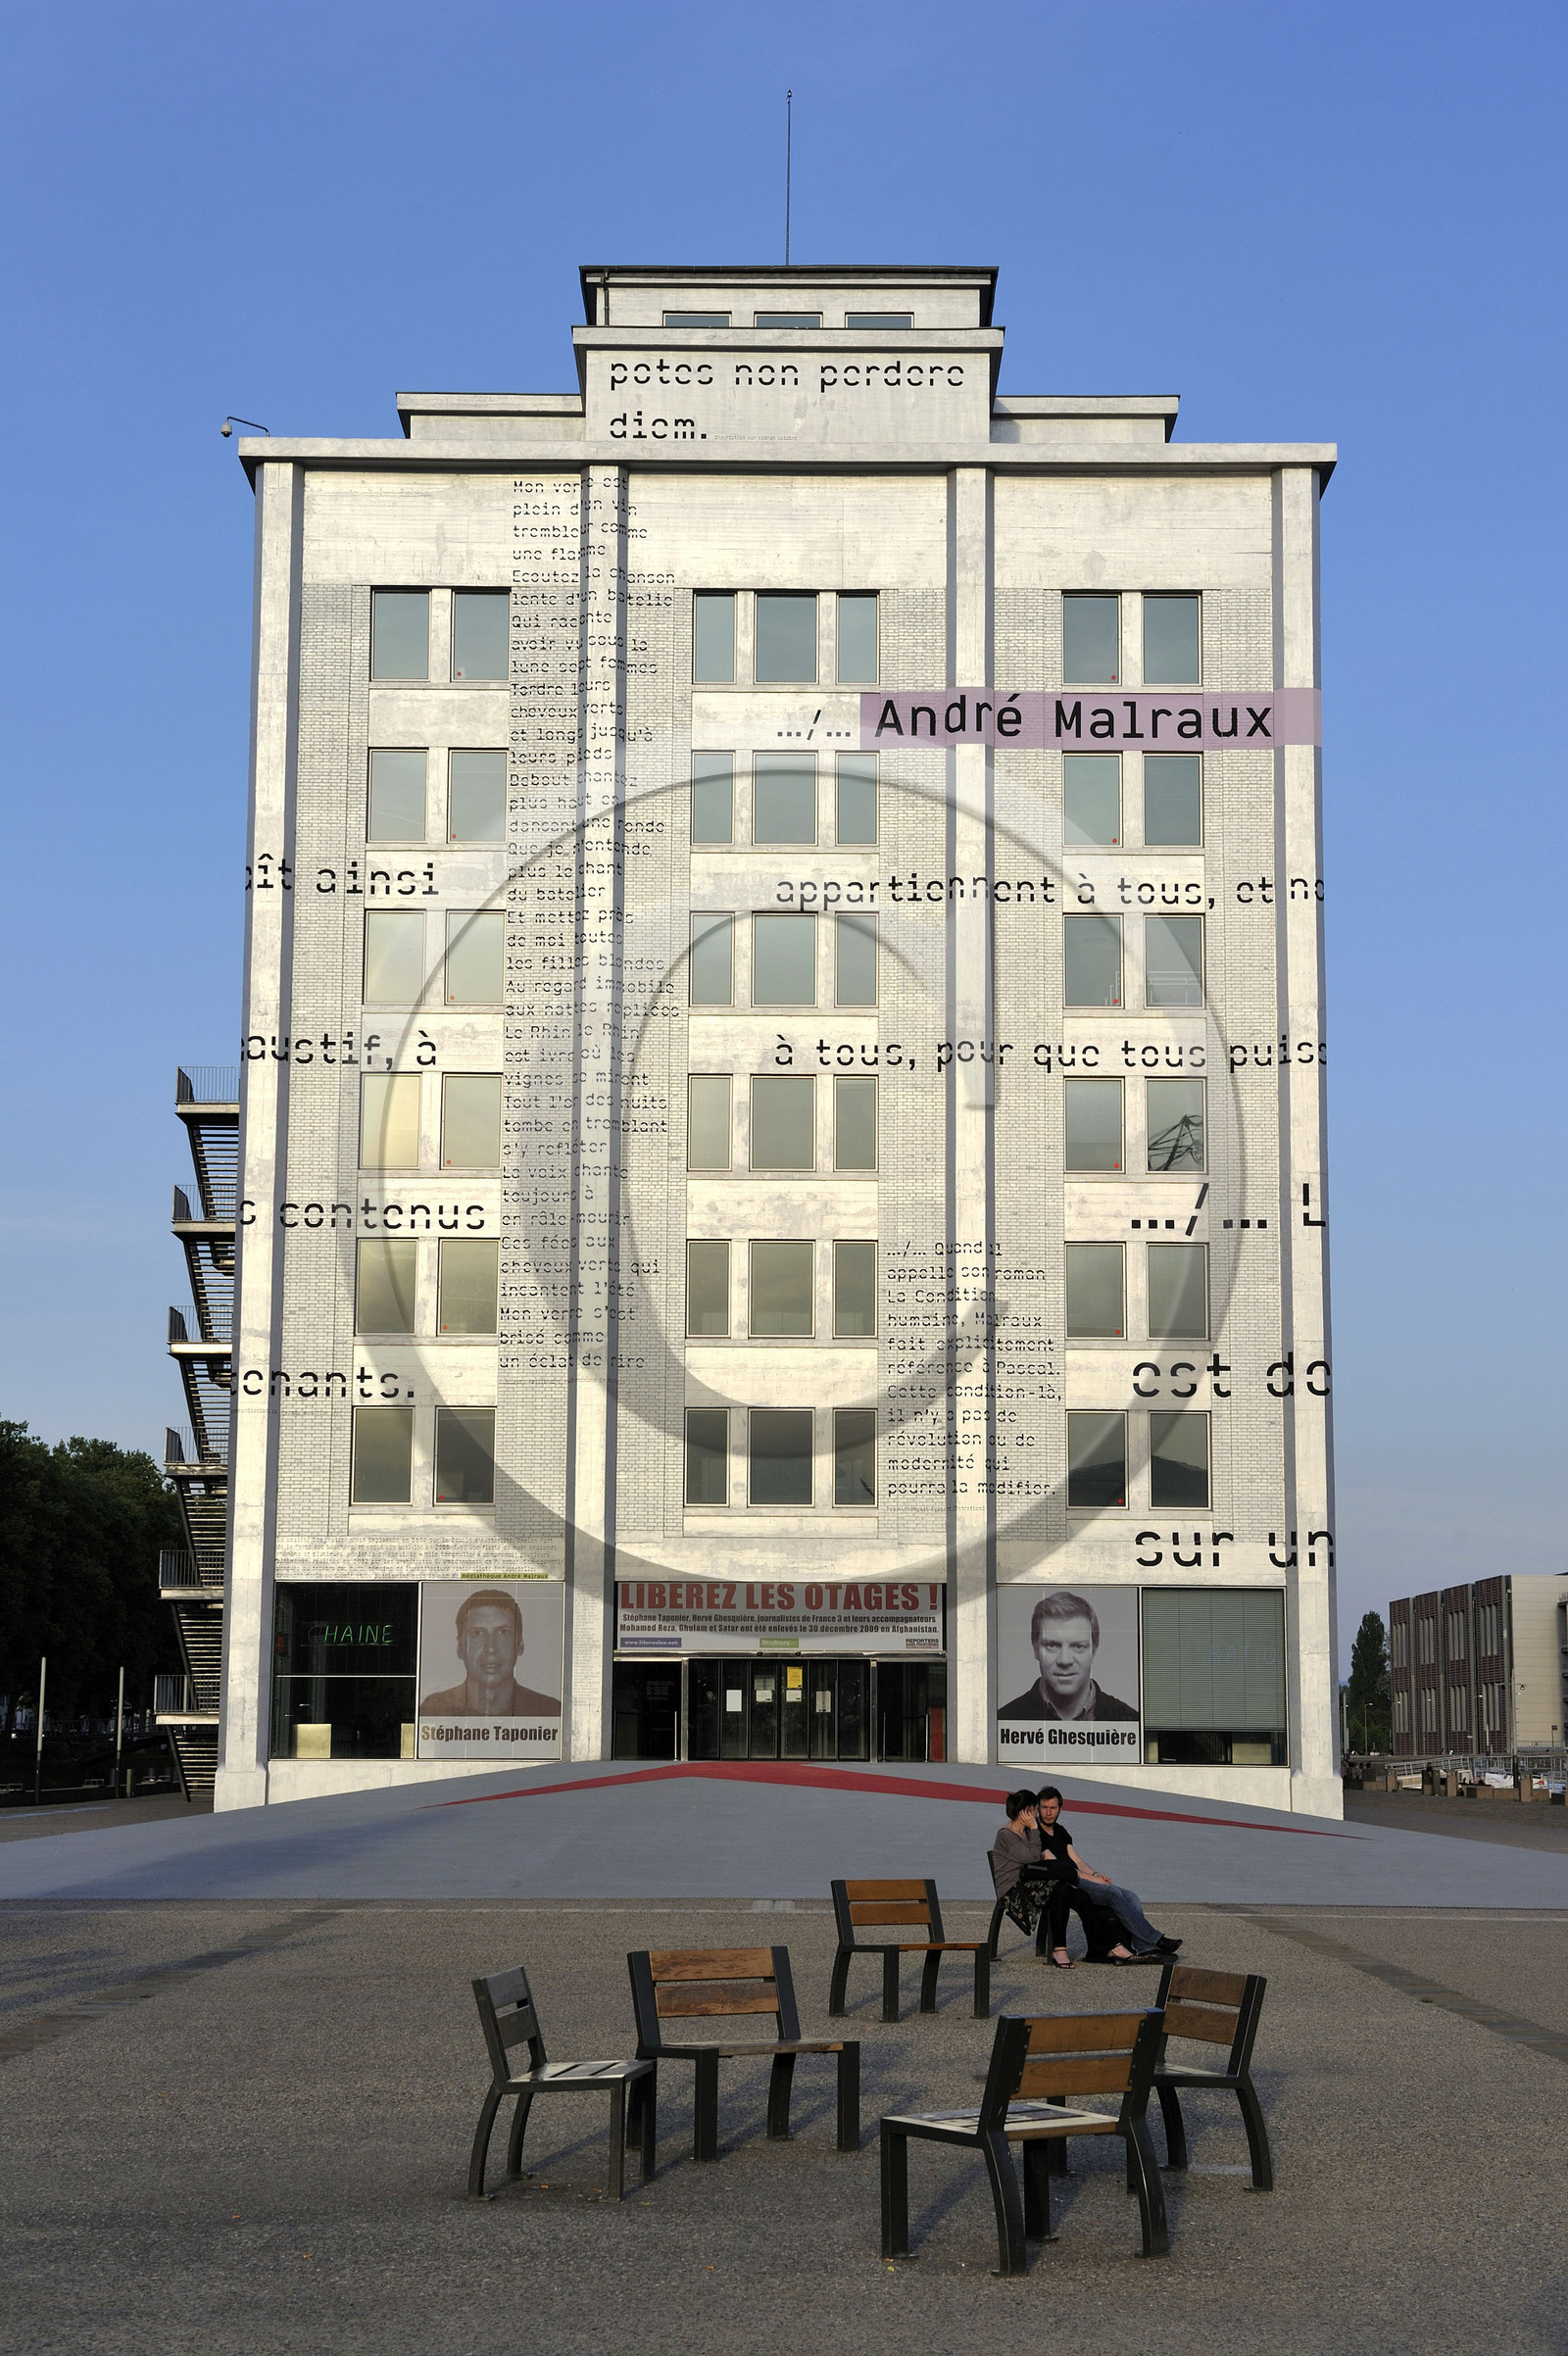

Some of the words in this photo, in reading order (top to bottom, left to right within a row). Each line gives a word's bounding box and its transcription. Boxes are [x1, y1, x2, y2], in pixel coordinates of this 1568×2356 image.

[875, 694, 1023, 738] André
[1054, 700, 1273, 739] Malraux
[317, 861, 438, 895] ainsi
[776, 873, 1055, 910] appartiennent
[1078, 873, 1096, 904] à
[1117, 875, 1215, 909] tous,
[1236, 876, 1274, 903] et
[241, 1032, 392, 1070] austif,
[416, 1030, 436, 1065] à
[775, 1034, 792, 1065] à
[816, 1039, 916, 1070] tous,
[937, 1040, 1014, 1072] pour
[1034, 1042, 1100, 1073] que
[1121, 1040, 1206, 1067] tous
[280, 1199, 484, 1229] contenus
[1133, 1353, 1231, 1398] est
[1267, 1351, 1331, 1397] de
[1136, 1531, 1234, 1566] sur
[1269, 1531, 1334, 1567] un
[621, 1584, 736, 1609] LIBEREZ
[747, 1584, 795, 1610] LES
[805, 1584, 919, 1610] OTAGES
[929, 1585, 938, 1610] !
[421, 1725, 489, 1742] Stéphane
[494, 1726, 558, 1741] Taponier
[1001, 1729, 1044, 1744] Hervé
[1049, 1729, 1136, 1746] Ghesquière
